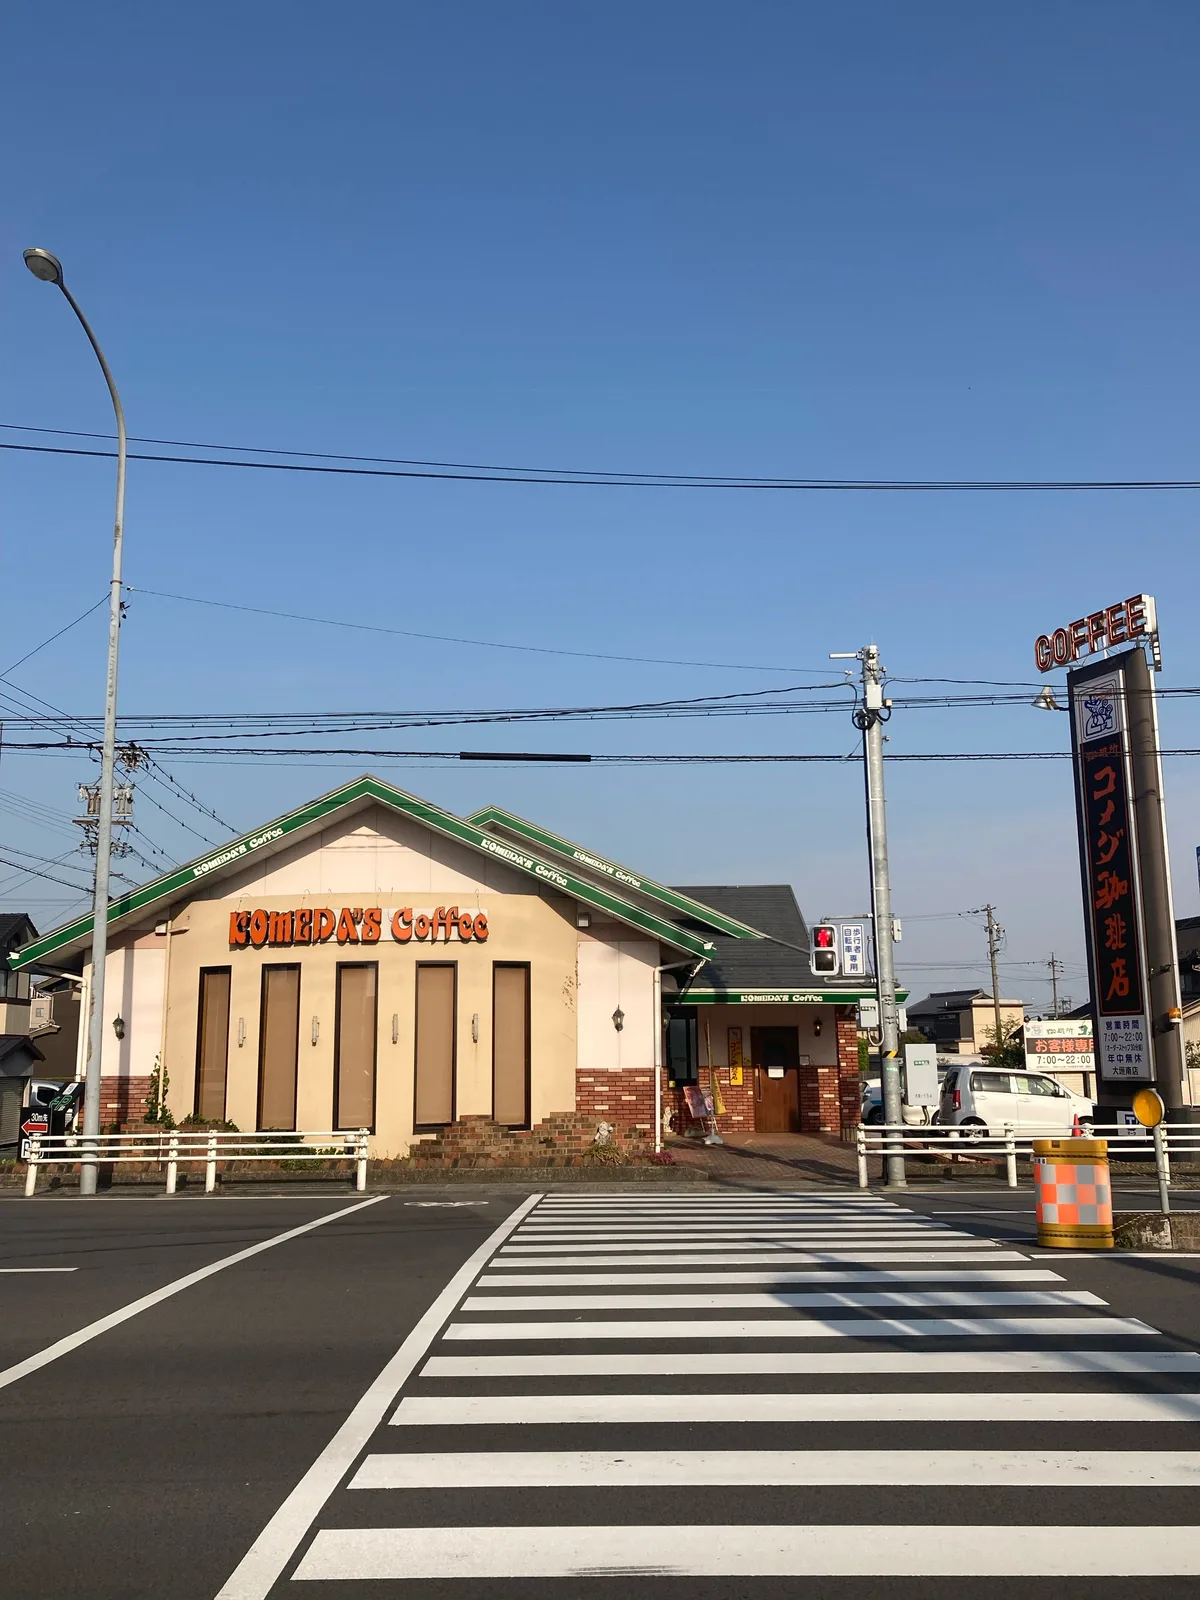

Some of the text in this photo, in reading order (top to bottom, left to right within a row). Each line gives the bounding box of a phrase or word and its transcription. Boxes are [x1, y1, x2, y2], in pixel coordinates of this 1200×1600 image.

[1035, 593, 1147, 672] COFFEE
[192, 827, 284, 876] KOMEDA'S Coffee
[480, 838, 568, 887] KOMEDA'S Coffee
[573, 850, 641, 888] KOMEDA'S Coffee
[229, 906, 489, 945] KOMEDA'S Coffee
[849, 954, 858, 971] 専用
[740, 994, 823, 1002] KOMEDA'S Coffee
[1105, 1020, 1139, 1030] 営業時間
[1107, 1053, 1142, 1063] 年中無休
